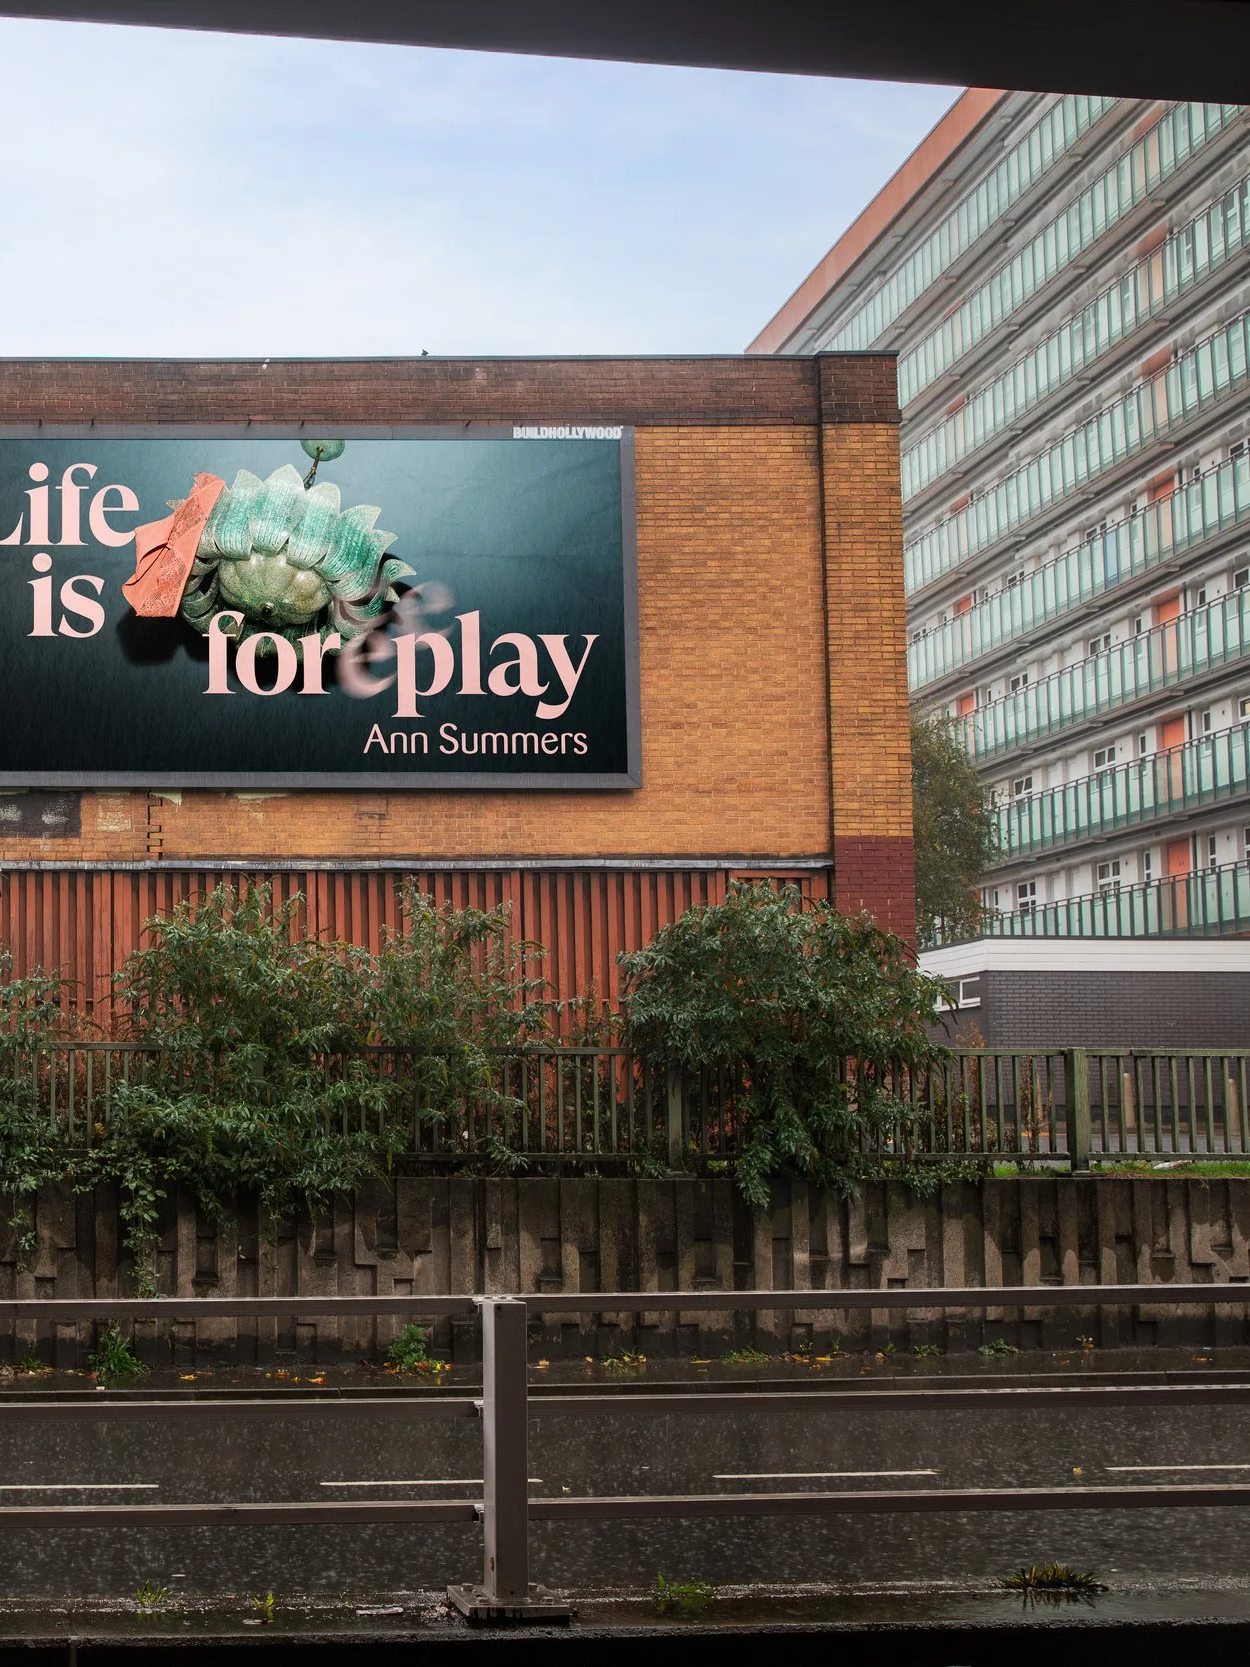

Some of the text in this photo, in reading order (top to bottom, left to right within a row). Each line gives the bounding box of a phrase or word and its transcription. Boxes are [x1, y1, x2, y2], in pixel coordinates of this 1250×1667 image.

[26, 552, 106, 638] is
[363, 723, 589, 755] Ann Summers
